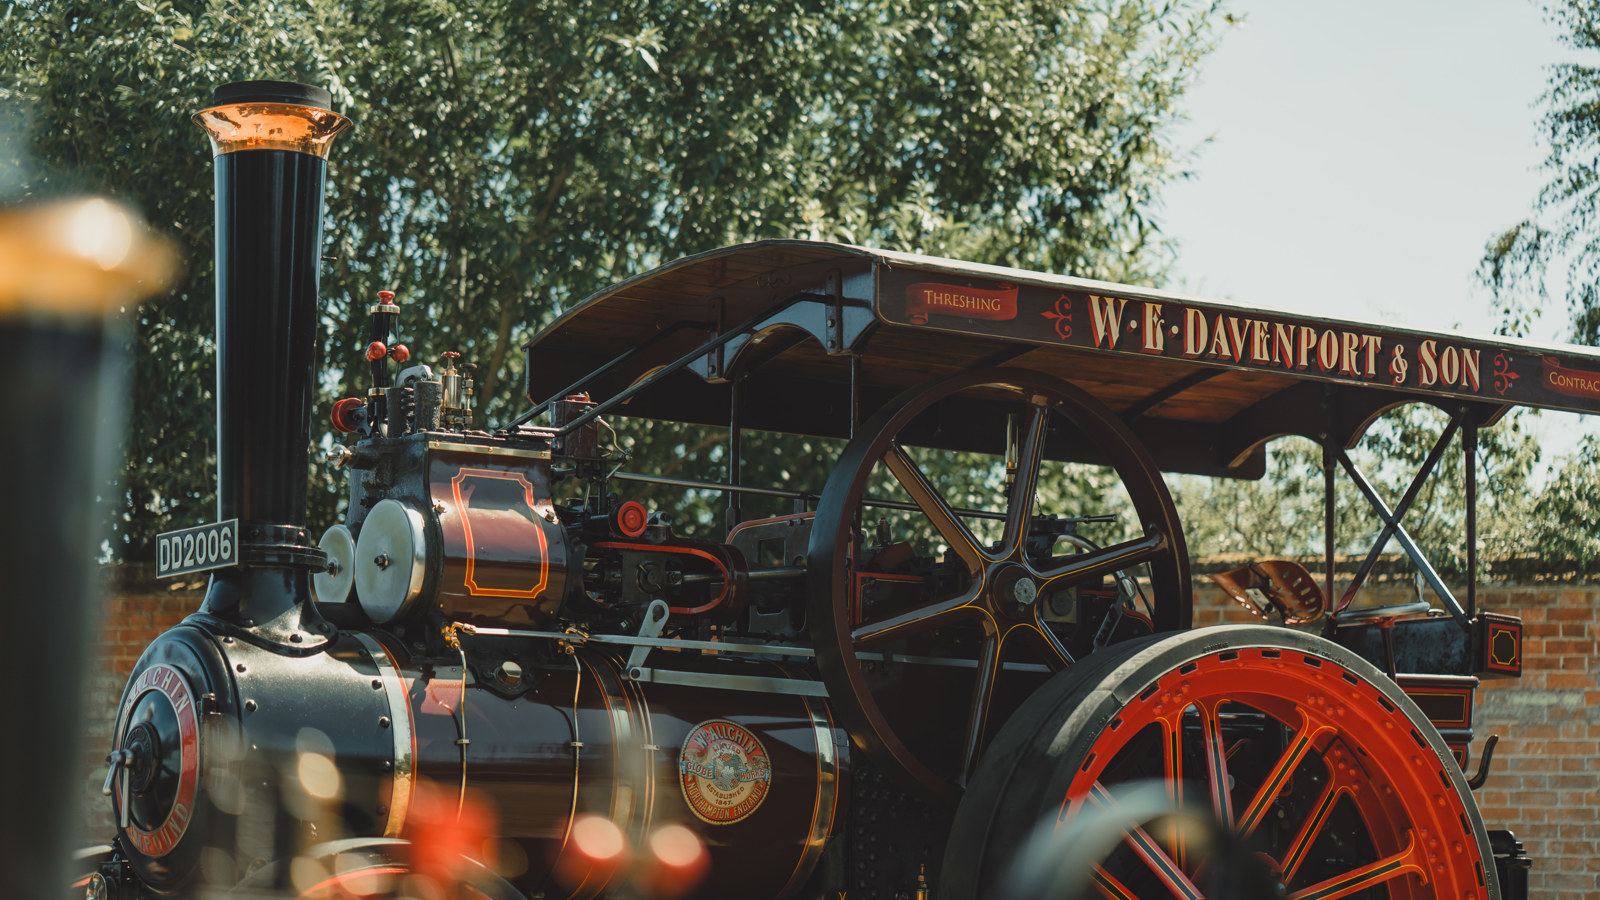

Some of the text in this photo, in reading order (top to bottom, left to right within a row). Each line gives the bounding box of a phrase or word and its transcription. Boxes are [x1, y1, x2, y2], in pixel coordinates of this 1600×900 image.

[924, 289, 1001, 312] THRESHING
[1390, 344, 1408, 386] &
[1419, 339, 1481, 392] SON
[1549, 371, 1600, 392] CONTRAC
[159, 526, 232, 572] DD2006
[686, 761, 713, 778] GLOBE
[740, 768, 765, 781] WORKS
[706, 783, 745, 800] ESTABLISHED
[125, 803, 188, 853] OMPOUND
